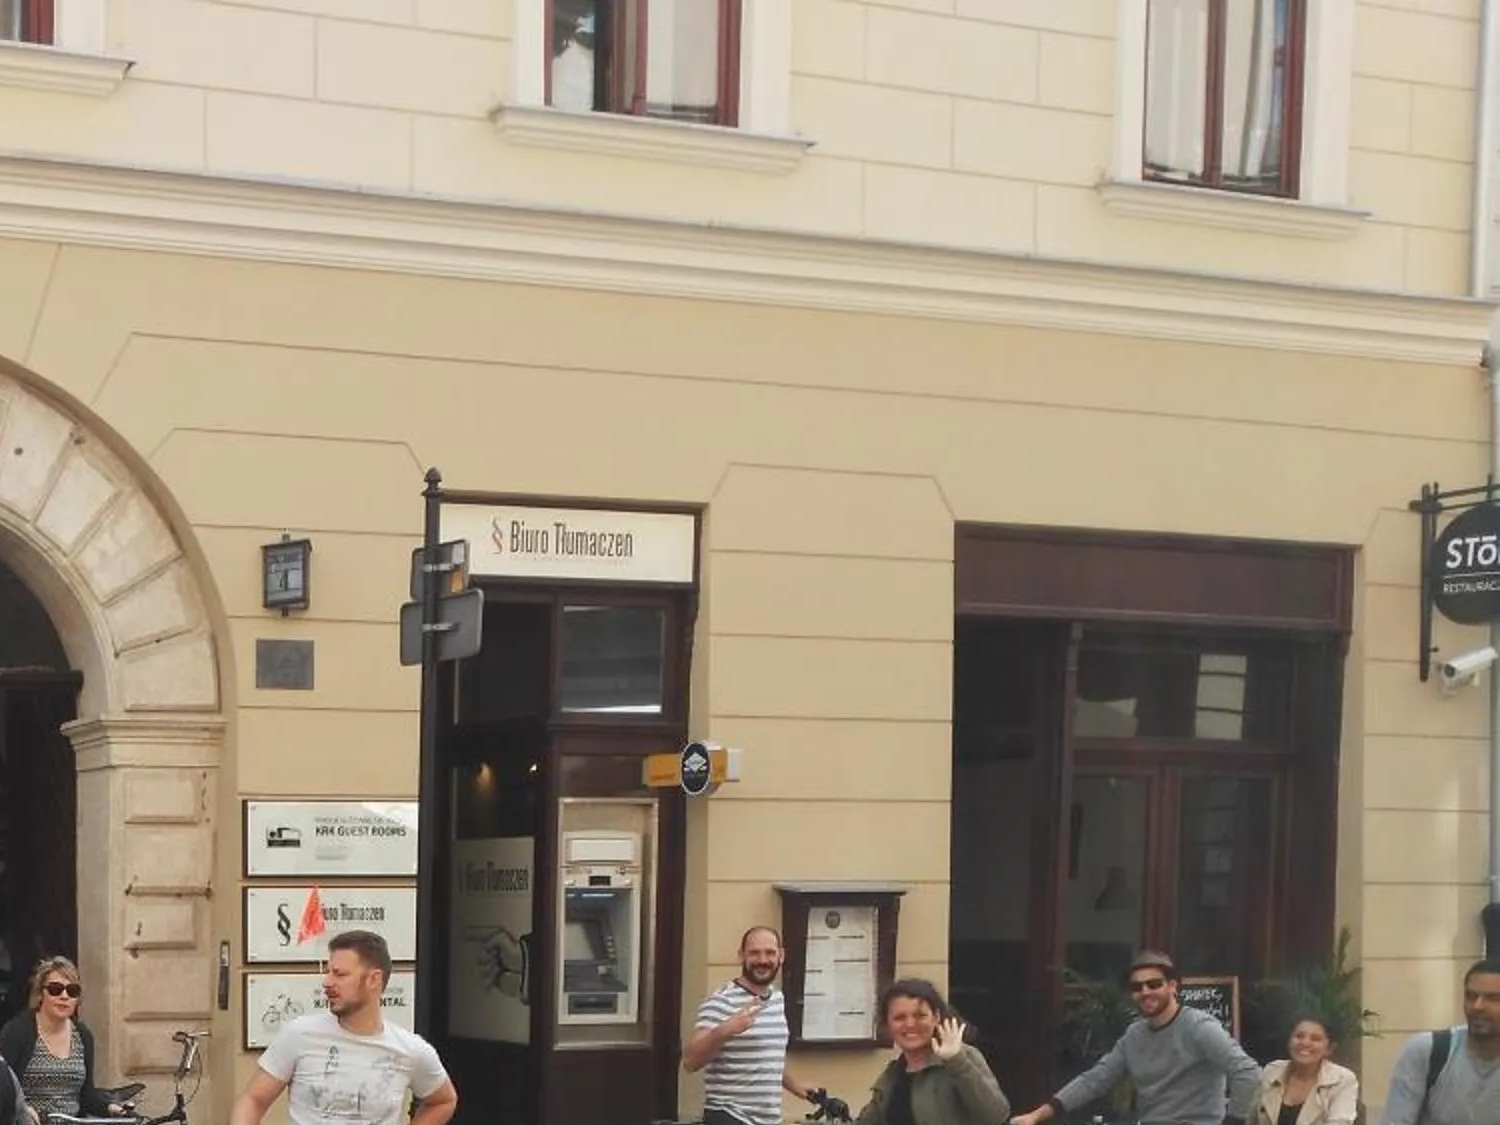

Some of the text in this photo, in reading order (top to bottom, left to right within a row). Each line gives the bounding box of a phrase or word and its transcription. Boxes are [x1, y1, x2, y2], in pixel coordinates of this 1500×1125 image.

[509, 520, 549, 553] Biuro
[337, 825, 369, 837] GUEST
[371, 825, 407, 837] ROOMS
[379, 997, 407, 1008] NTAL
